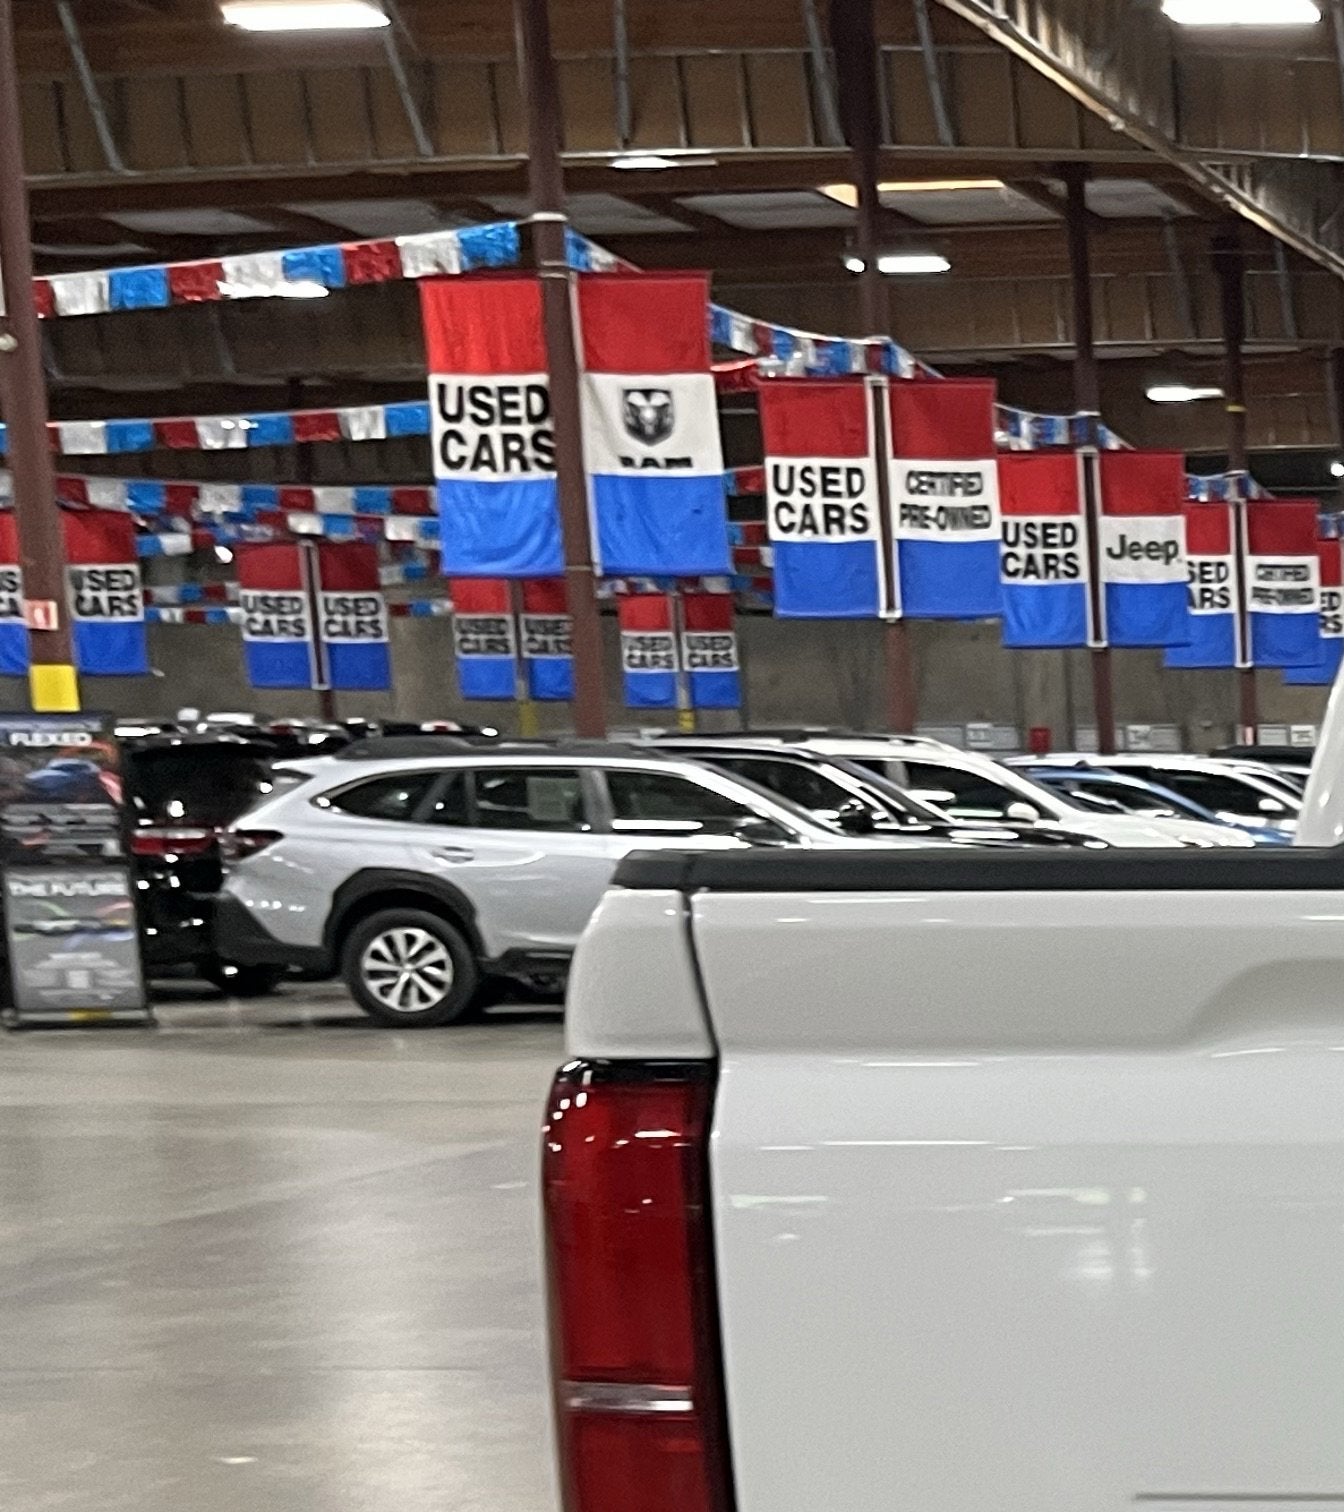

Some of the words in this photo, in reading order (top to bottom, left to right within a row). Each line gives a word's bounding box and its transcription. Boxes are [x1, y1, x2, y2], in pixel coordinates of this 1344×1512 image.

[437, 383, 550, 426] USED
[440, 429, 557, 472] CARS
[772, 464, 866, 498] USED
[774, 501, 870, 535] CARS
[1001, 521, 1077, 549] USED
[1106, 534, 1180, 566] Jeep
[1001, 552, 1080, 579] CARS
[1187, 561, 1230, 584] SED
[241, 595, 303, 615] USED
[323, 597, 379, 617] USED
[246, 617, 305, 637] CARS
[324, 619, 382, 638] CARS
[524, 619, 570, 635] USE
